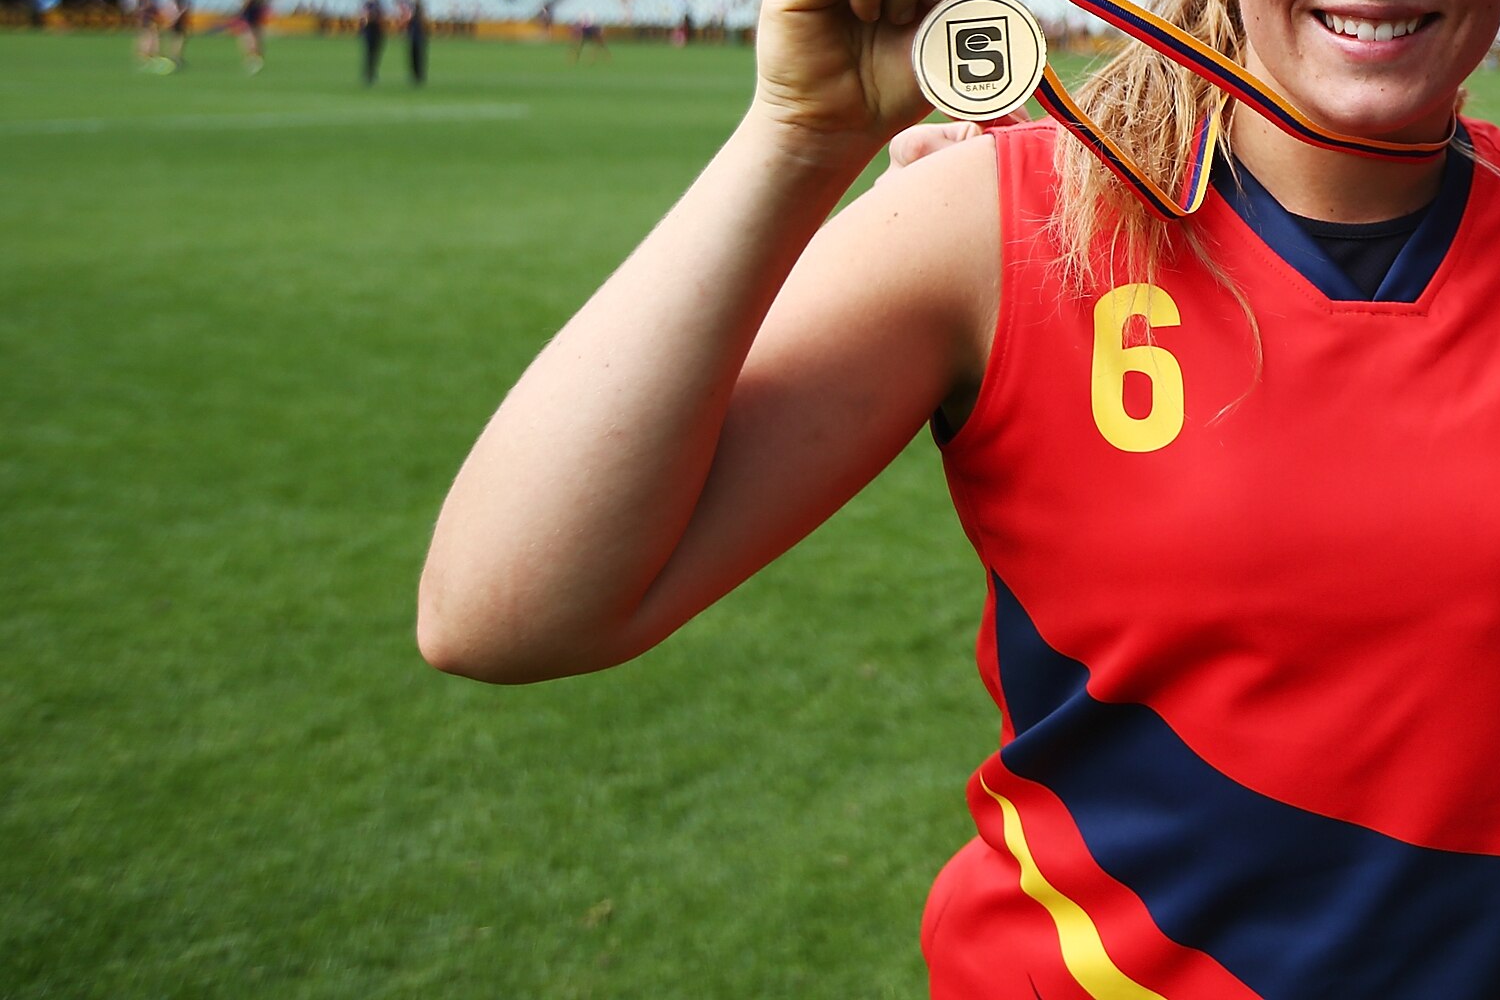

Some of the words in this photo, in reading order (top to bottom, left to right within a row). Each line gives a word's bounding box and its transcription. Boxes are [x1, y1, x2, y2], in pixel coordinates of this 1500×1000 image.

[955, 26, 1005, 84] S
[965, 83, 998, 93] SANFL
[1091, 282, 1185, 453] 6
